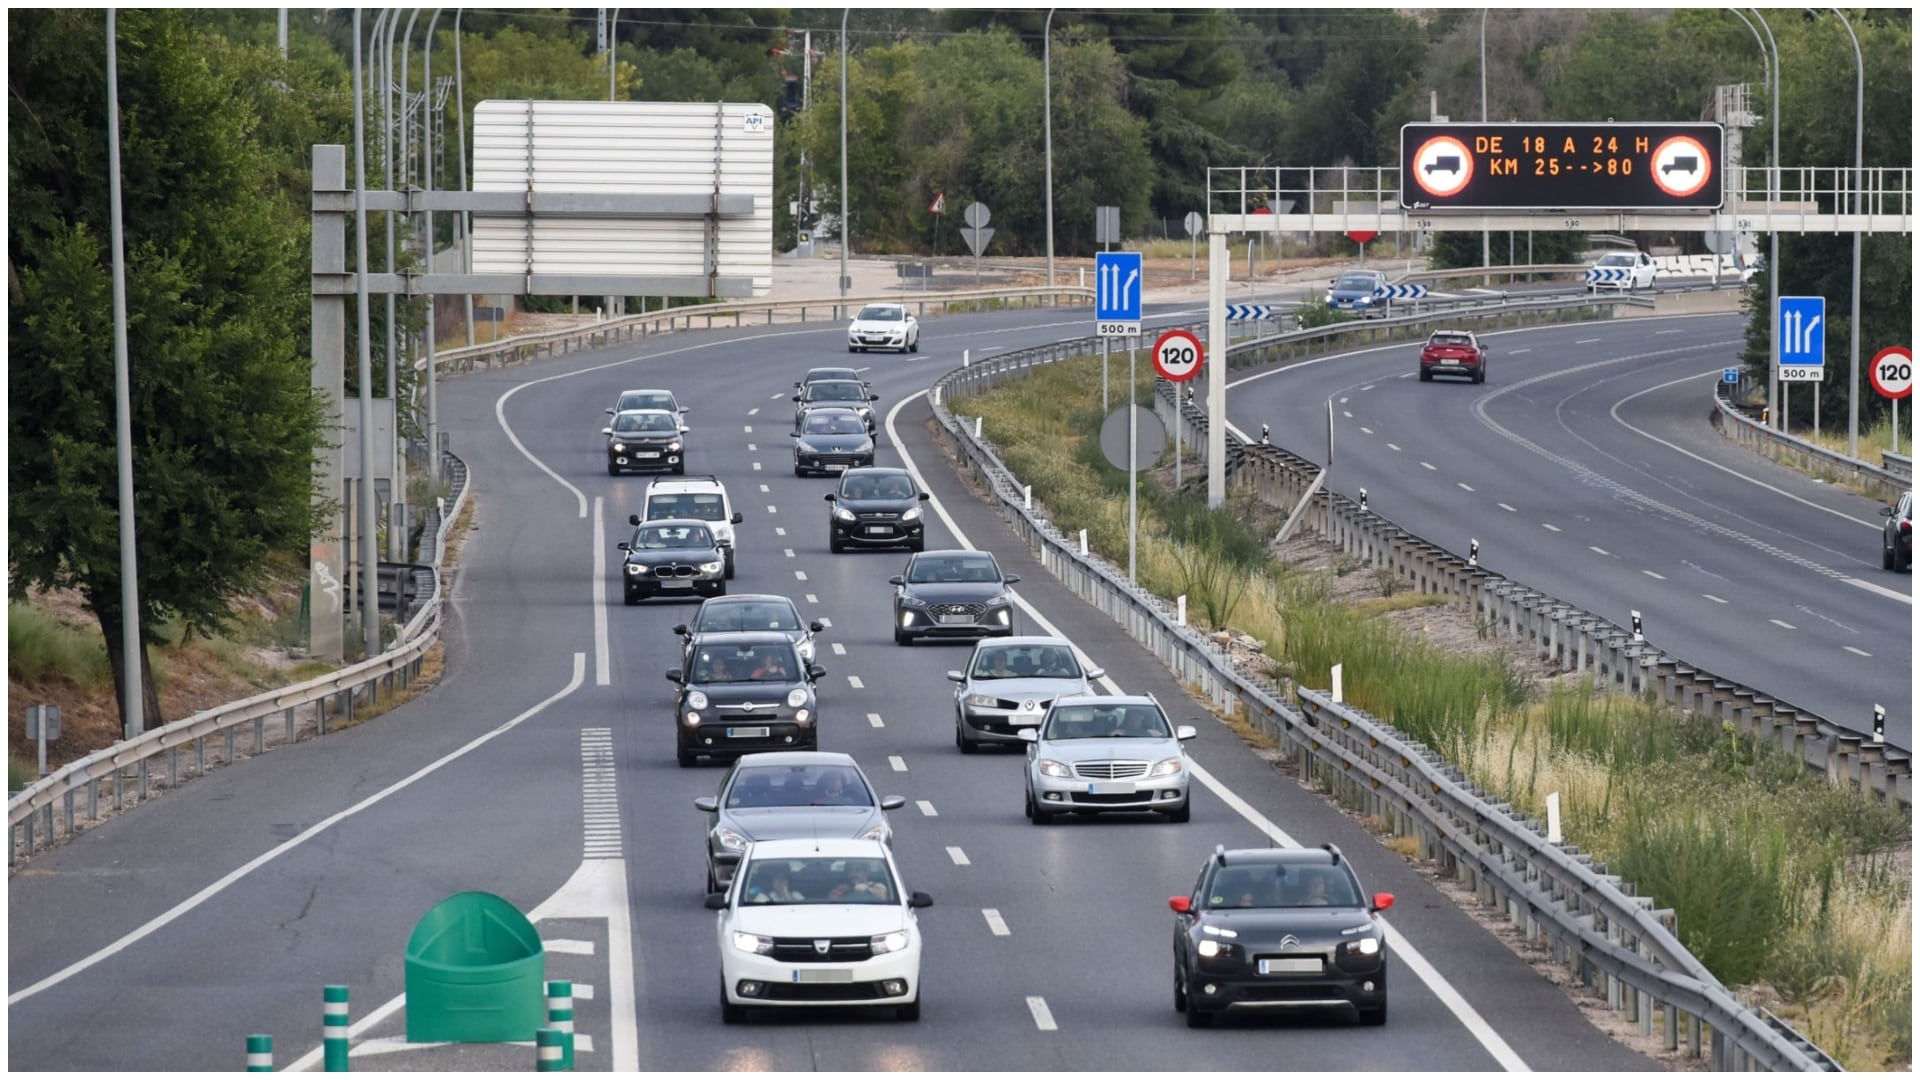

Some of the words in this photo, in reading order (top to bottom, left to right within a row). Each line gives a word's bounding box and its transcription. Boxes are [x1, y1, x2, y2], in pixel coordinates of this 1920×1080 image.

[1476, 136, 1503, 153] DE
[1522, 136, 1545, 153] 18
[1563, 136, 1576, 153] A
[1593, 136, 1618, 153] 24
[1635, 136, 1649, 153] H
[1490, 158, 1519, 175] KM
[1101, 324, 1124, 333] 500
[1162, 348, 1194, 364] 120
[1783, 369, 1806, 378] 500
[1879, 364, 1911, 381] 120
